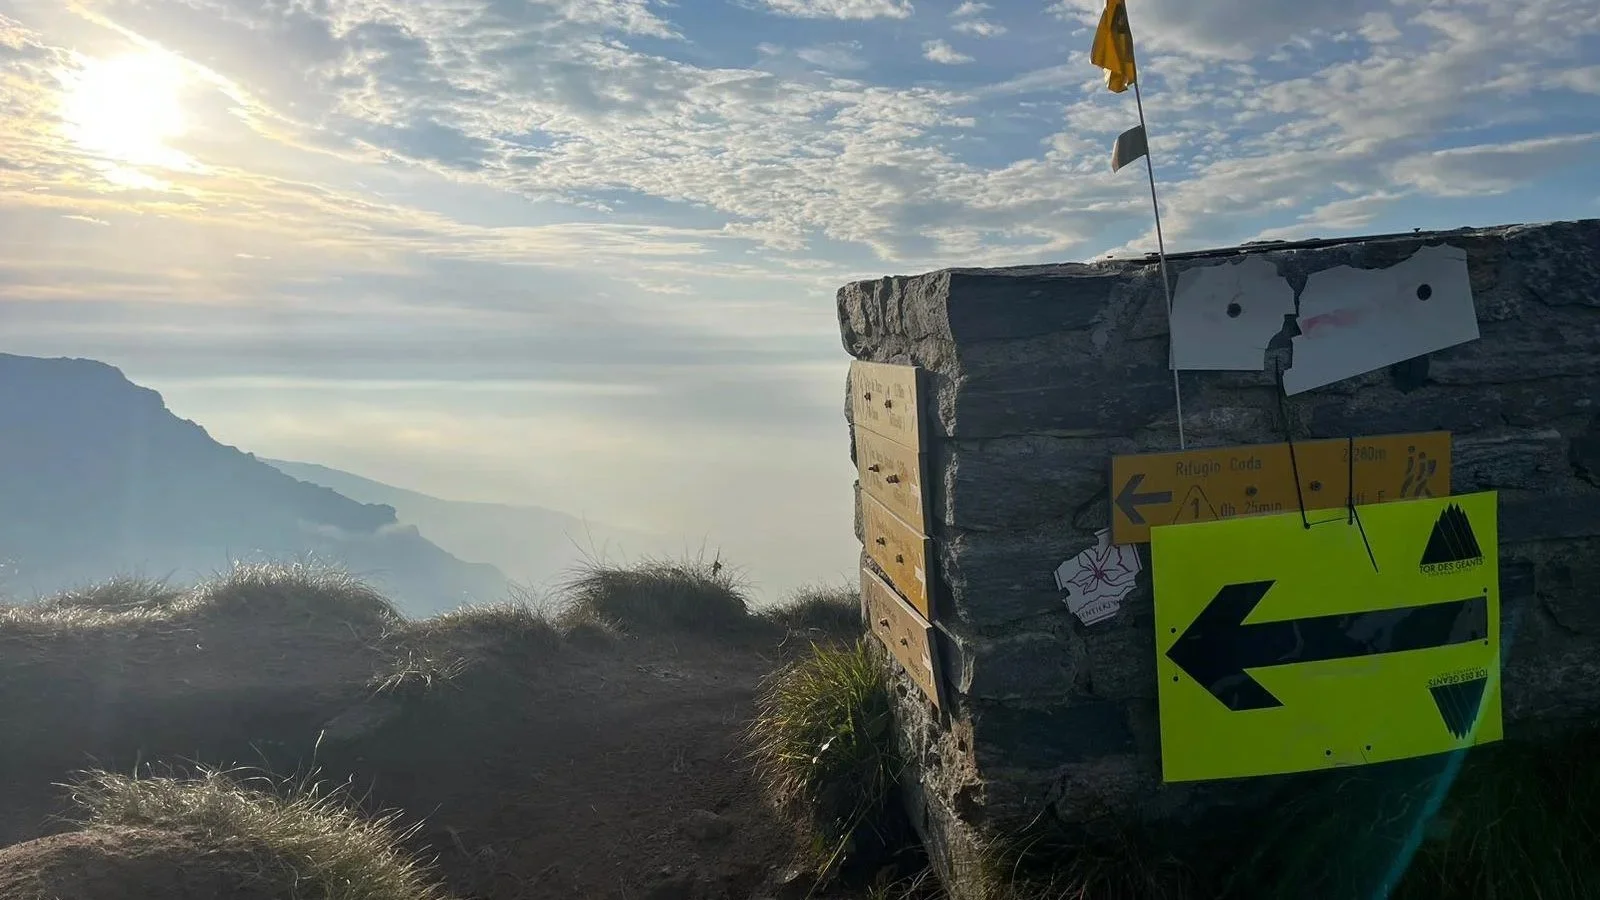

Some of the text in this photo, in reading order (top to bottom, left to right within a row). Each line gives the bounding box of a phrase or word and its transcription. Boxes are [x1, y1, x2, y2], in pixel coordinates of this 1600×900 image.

[1176, 456, 1262, 477] Rifugio Coda
[1191, 498, 1200, 519] 1
[1419, 564, 1436, 573] TOR
[1438, 562, 1454, 572] DES
